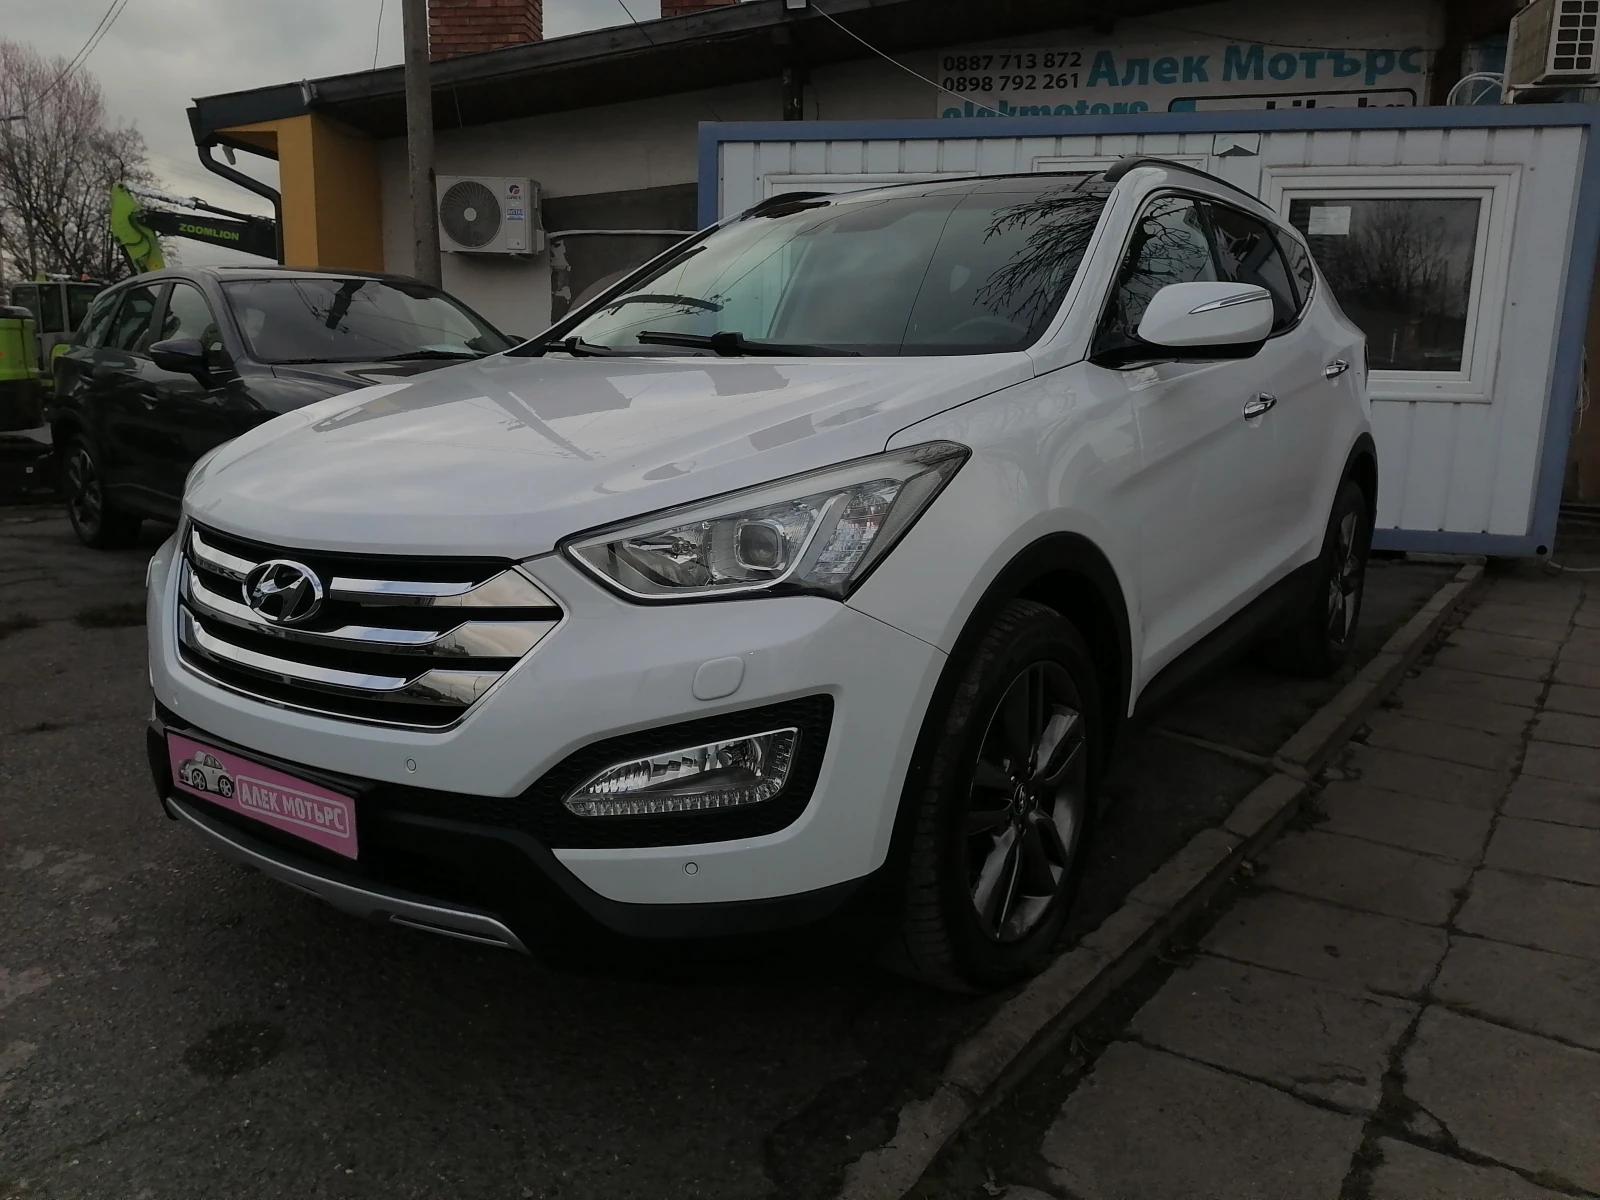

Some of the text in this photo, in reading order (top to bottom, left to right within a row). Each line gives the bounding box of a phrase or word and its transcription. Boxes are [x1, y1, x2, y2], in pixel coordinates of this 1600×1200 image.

[943, 51, 1081, 71] 0887 713 872
[1086, 44, 1423, 87] Алек Мотърс
[943, 72, 1079, 92] 0898 792 261
[178, 223, 239, 240] ZOOMLION
[242, 783, 281, 813] АЛЕК
